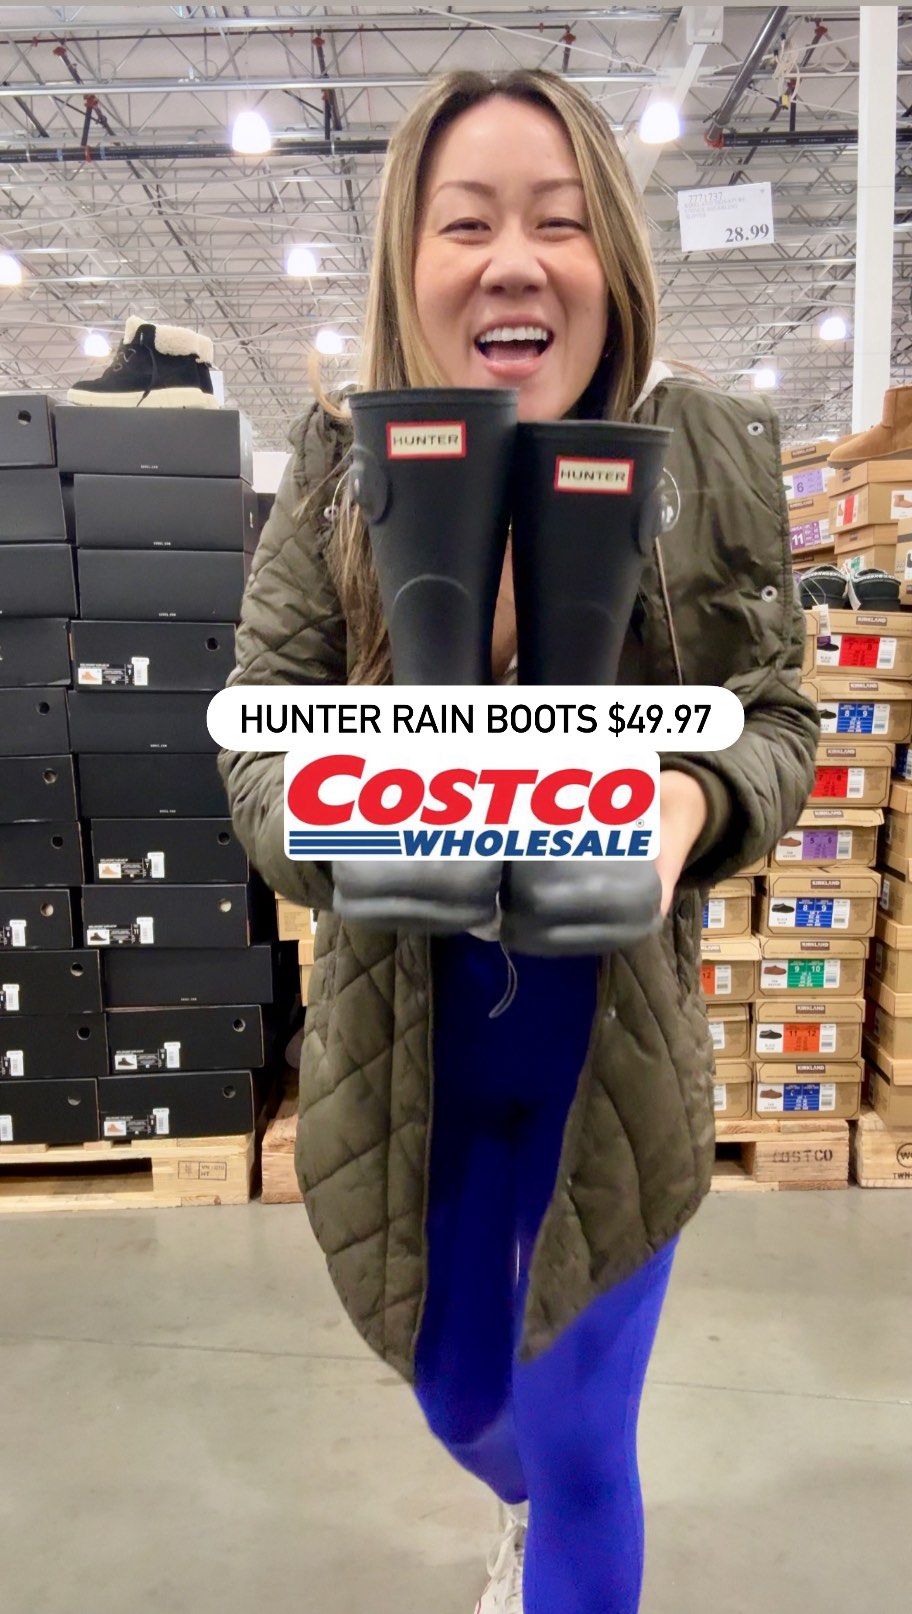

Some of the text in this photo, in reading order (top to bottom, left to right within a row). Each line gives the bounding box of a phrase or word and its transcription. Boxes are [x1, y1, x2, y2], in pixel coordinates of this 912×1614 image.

[688, 192, 723, 203] 7771737
[725, 224, 769, 243] 28.99
[393, 434, 459, 446] HUNTER
[561, 469, 626, 482] HUNTER
[796, 482, 804, 493] 6
[792, 533, 804, 546] 11
[821, 904, 827, 912] 9
[794, 965, 820, 973] 9 10
[773, 1149, 833, 1162] COSTCO
